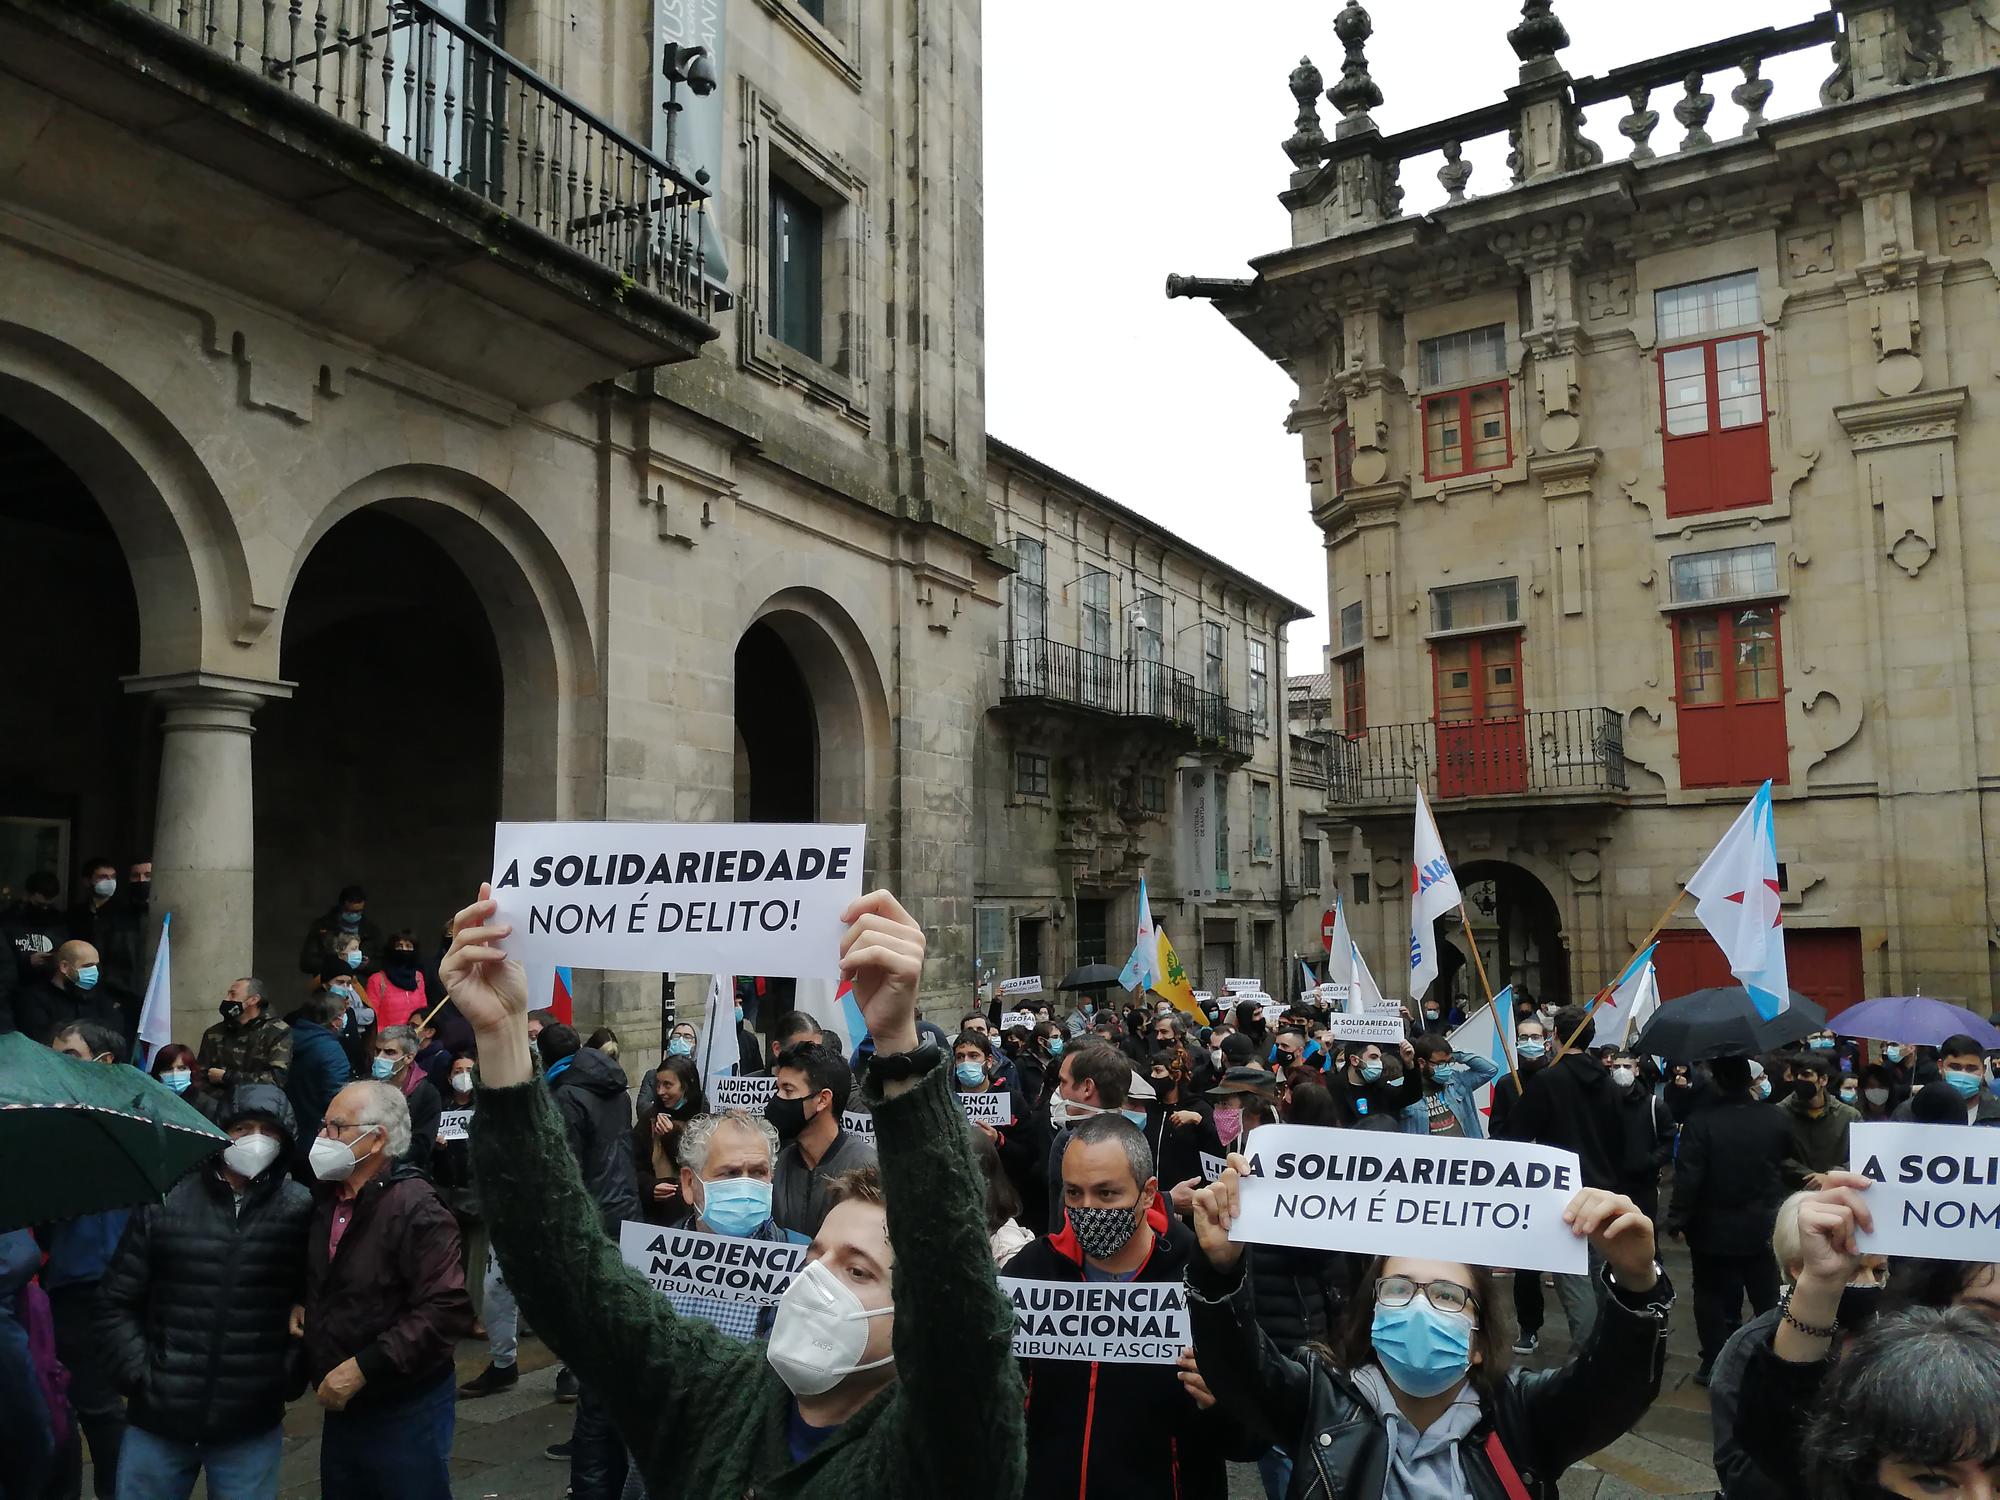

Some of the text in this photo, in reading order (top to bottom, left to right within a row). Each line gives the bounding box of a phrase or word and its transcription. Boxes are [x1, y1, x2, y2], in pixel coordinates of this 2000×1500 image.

[496, 847, 851, 888] A SOLIDARIEDADE
[529, 892, 800, 934] NOM É DELITO!
[1019, 978, 1039, 986] FARSA
[1361, 1026, 1366, 1035] É
[717, 1080, 779, 1092] AUDIENCIA
[719, 1092, 776, 1105] NACIONA
[962, 1095, 998, 1105] ENCIA
[965, 1105, 998, 1116] ONAL
[1248, 1152, 1571, 1191] A SOLIDARIEDADE
[1861, 1155, 1999, 1185] A SOLI
[1273, 1189, 1531, 1230] NOM É DELITO!
[1902, 1200, 2000, 1230] NOM
[650, 1256, 792, 1296] NACIONA
[648, 1277, 781, 1307] RIBUNAL FASC
[1012, 1287, 1183, 1312] AUDIENCIA
[1016, 1314, 1181, 1339] NACIONAL
[1012, 1341, 1187, 1359] RIBUNAL FASCIST
